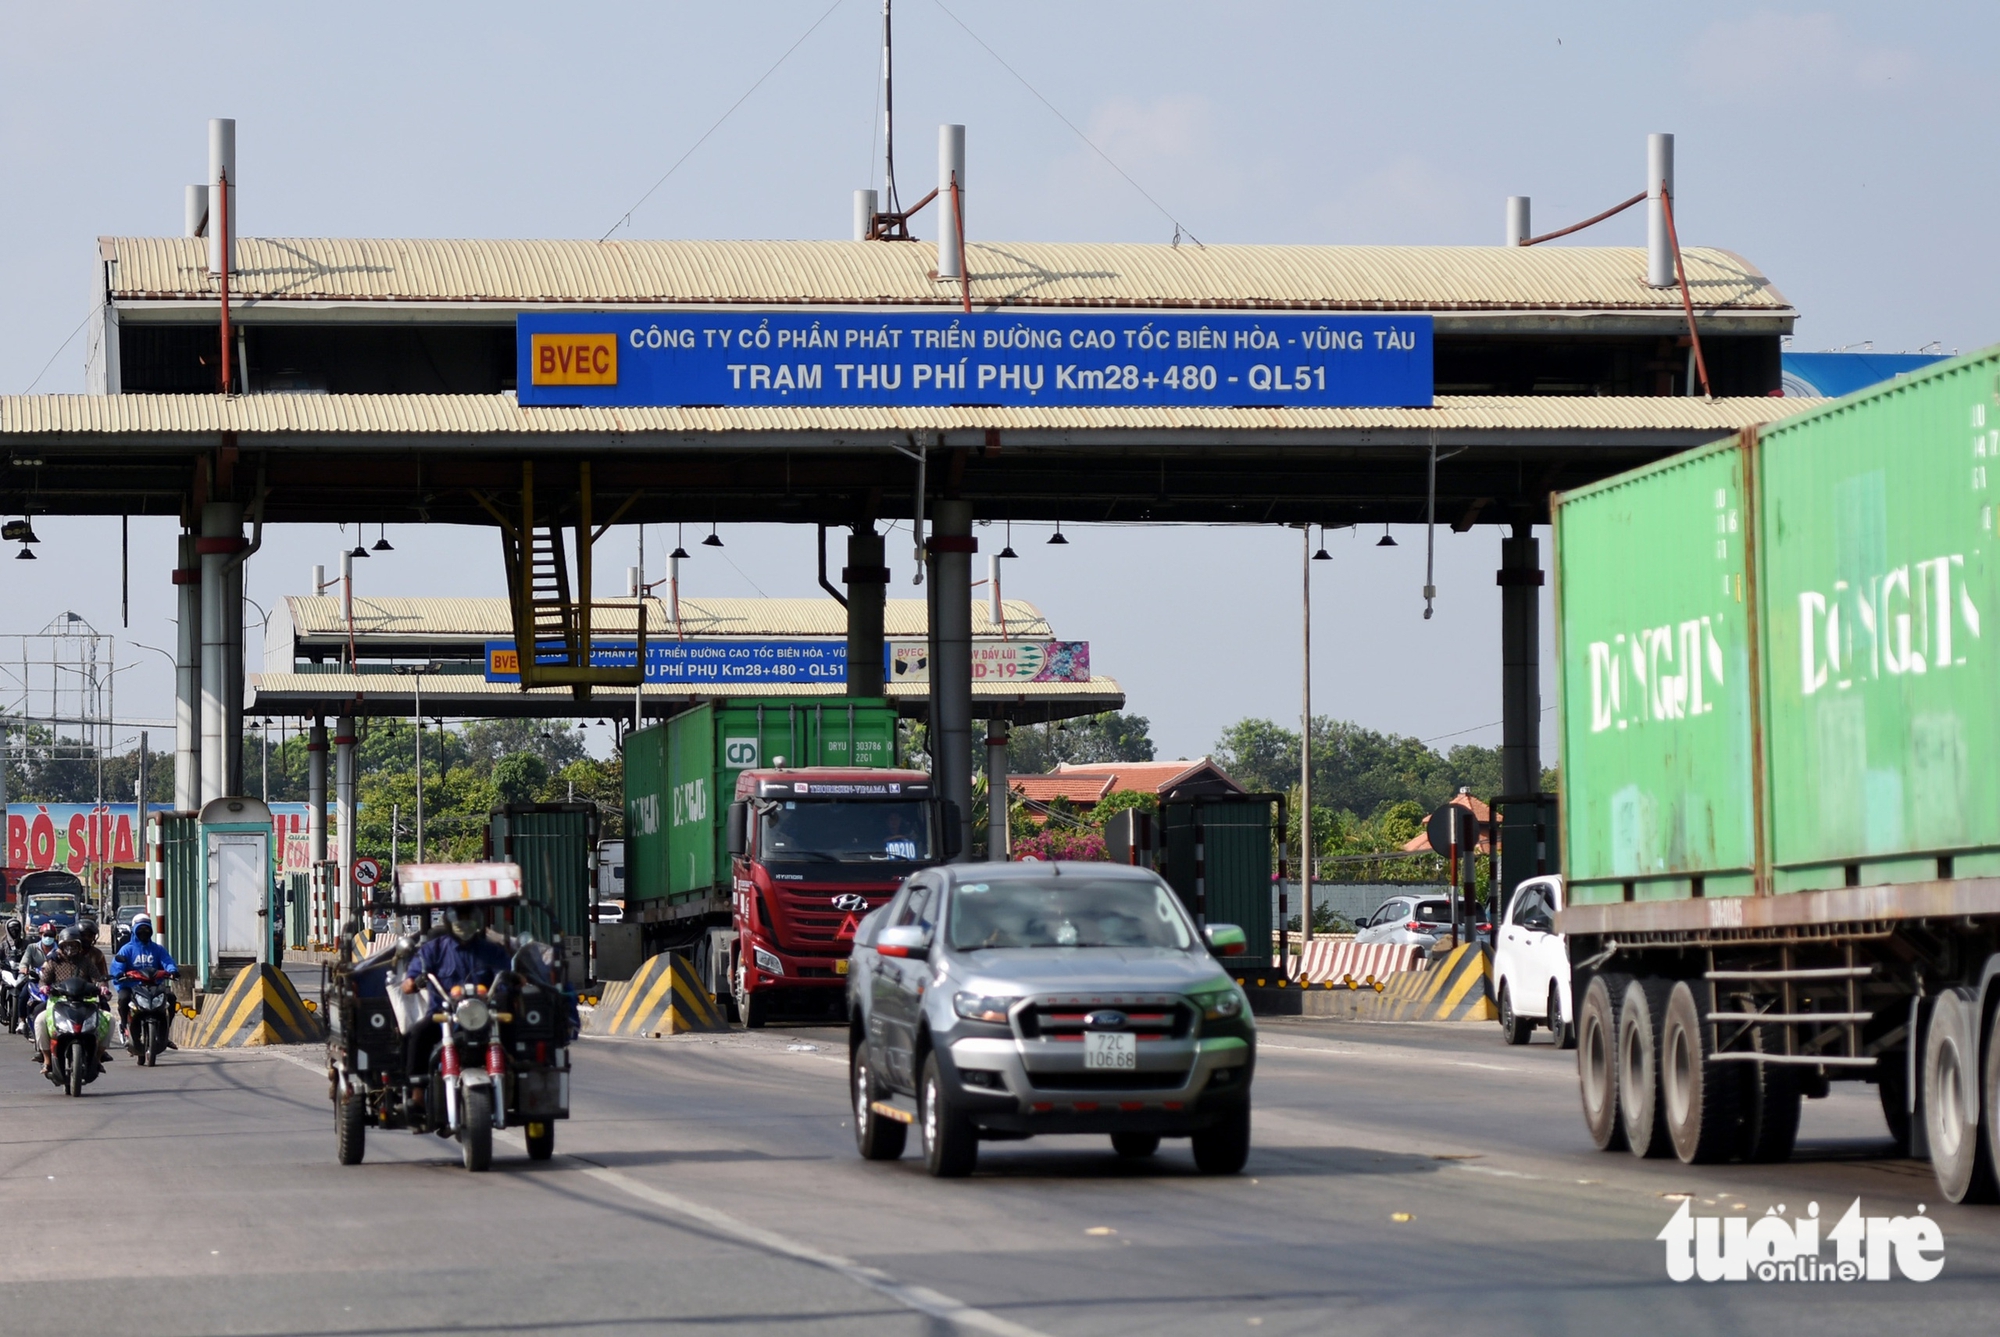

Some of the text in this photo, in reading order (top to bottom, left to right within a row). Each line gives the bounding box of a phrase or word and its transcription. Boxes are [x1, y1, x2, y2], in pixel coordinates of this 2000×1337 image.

[629, 324, 696, 349] CÔNG
[703, 329, 732, 349] TY
[738, 318, 771, 349] CỔ
[777, 320, 839, 349] PHẦN
[844, 324, 903, 349] PHÁT
[911, 319, 976, 349] TRIỂN
[983, 322, 1062, 350] ĐƯỜNG
[1069, 329, 1116, 350] CAO
[1123, 322, 1170, 350] TỐC
[1177, 326, 1227, 350] BIÊN
[1234, 324, 1280, 350] HÒA
[1301, 324, 1363, 351] VŨNG
[1374, 326, 1416, 351] TÀU
[539, 345, 610, 375] BVEC
[726, 363, 822, 395] TRẠM
[834, 363, 901, 390] THU
[912, 356, 966, 390] PHÍ
[977, 364, 1045, 396] PHỤ
[1056, 364, 1218, 391] Km28+480
[1248, 364, 1327, 392] QL51
[658, 645, 688, 658] TRIỂN
[690, 646, 726, 659] ĐƯỜNG
[728, 648, 750, 658] CAO
[753, 645, 774, 658] TỐC
[776, 647, 800, 658] BIÊN
[802, 646, 824, 658] HÒA
[897, 647, 924, 657] BVEC
[494, 655, 517, 669] BVE
[660, 662, 684, 677] PHÍ
[687, 663, 718, 679] PHỤ
[722, 663, 796, 677] Km28+480
[808, 663, 844, 677] QL51
[828, 741, 847, 751] DRYU
[856, 741, 882, 751] 303786
[8, 805, 136, 874] BÒ SỮA
[1097, 1035, 1124, 1051] 72C
